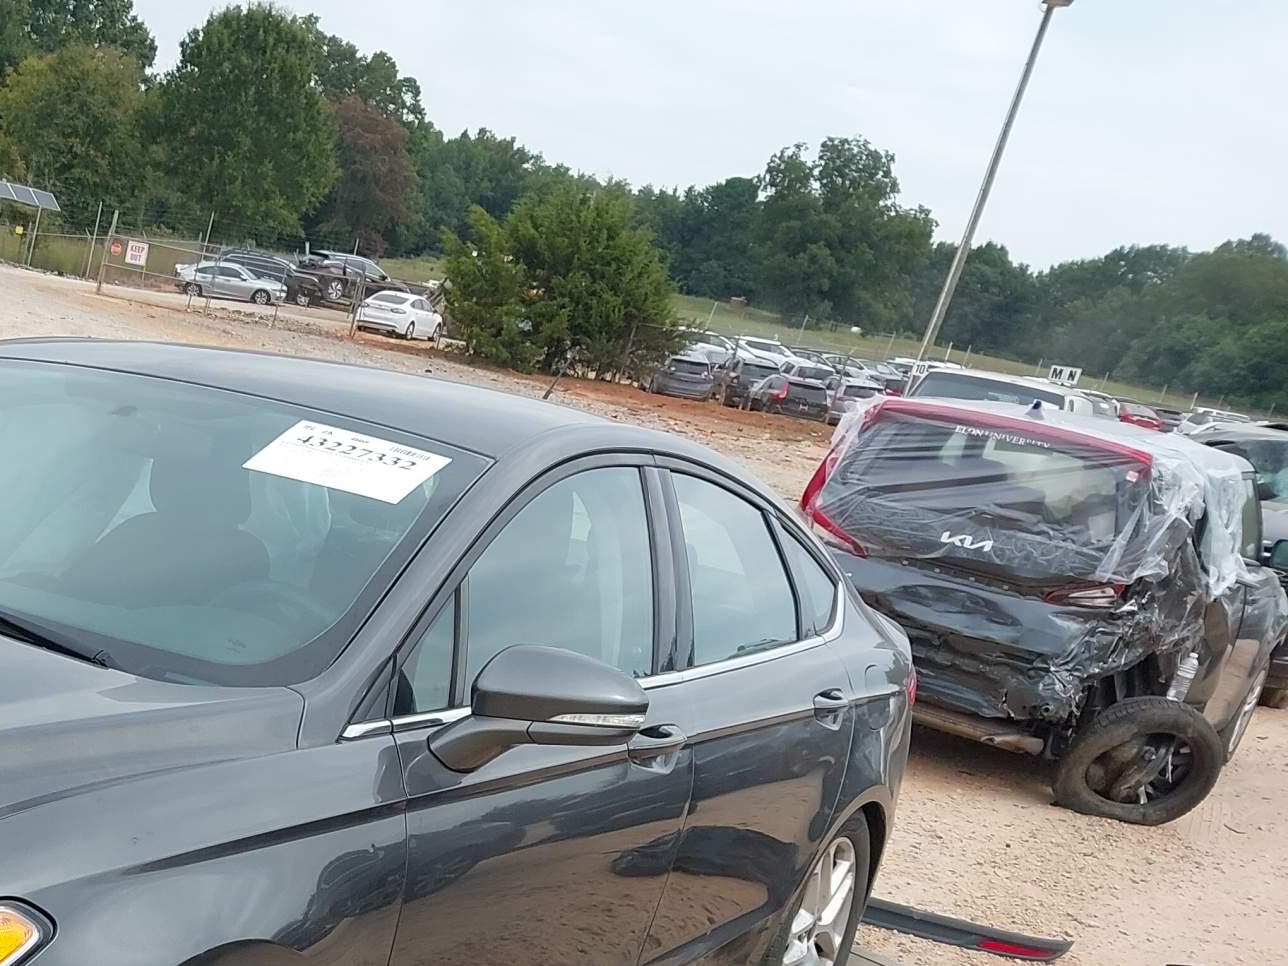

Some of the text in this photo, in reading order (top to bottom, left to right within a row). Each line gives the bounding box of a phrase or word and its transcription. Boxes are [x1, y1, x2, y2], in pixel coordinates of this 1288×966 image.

[130, 245, 145, 253] KEEP
[130, 253, 142, 261] OUT
[916, 364, 925, 375] 10
[1051, 367, 1077, 381] M N
[955, 425, 984, 437] ELON
[941, 531, 993, 552] KIA
